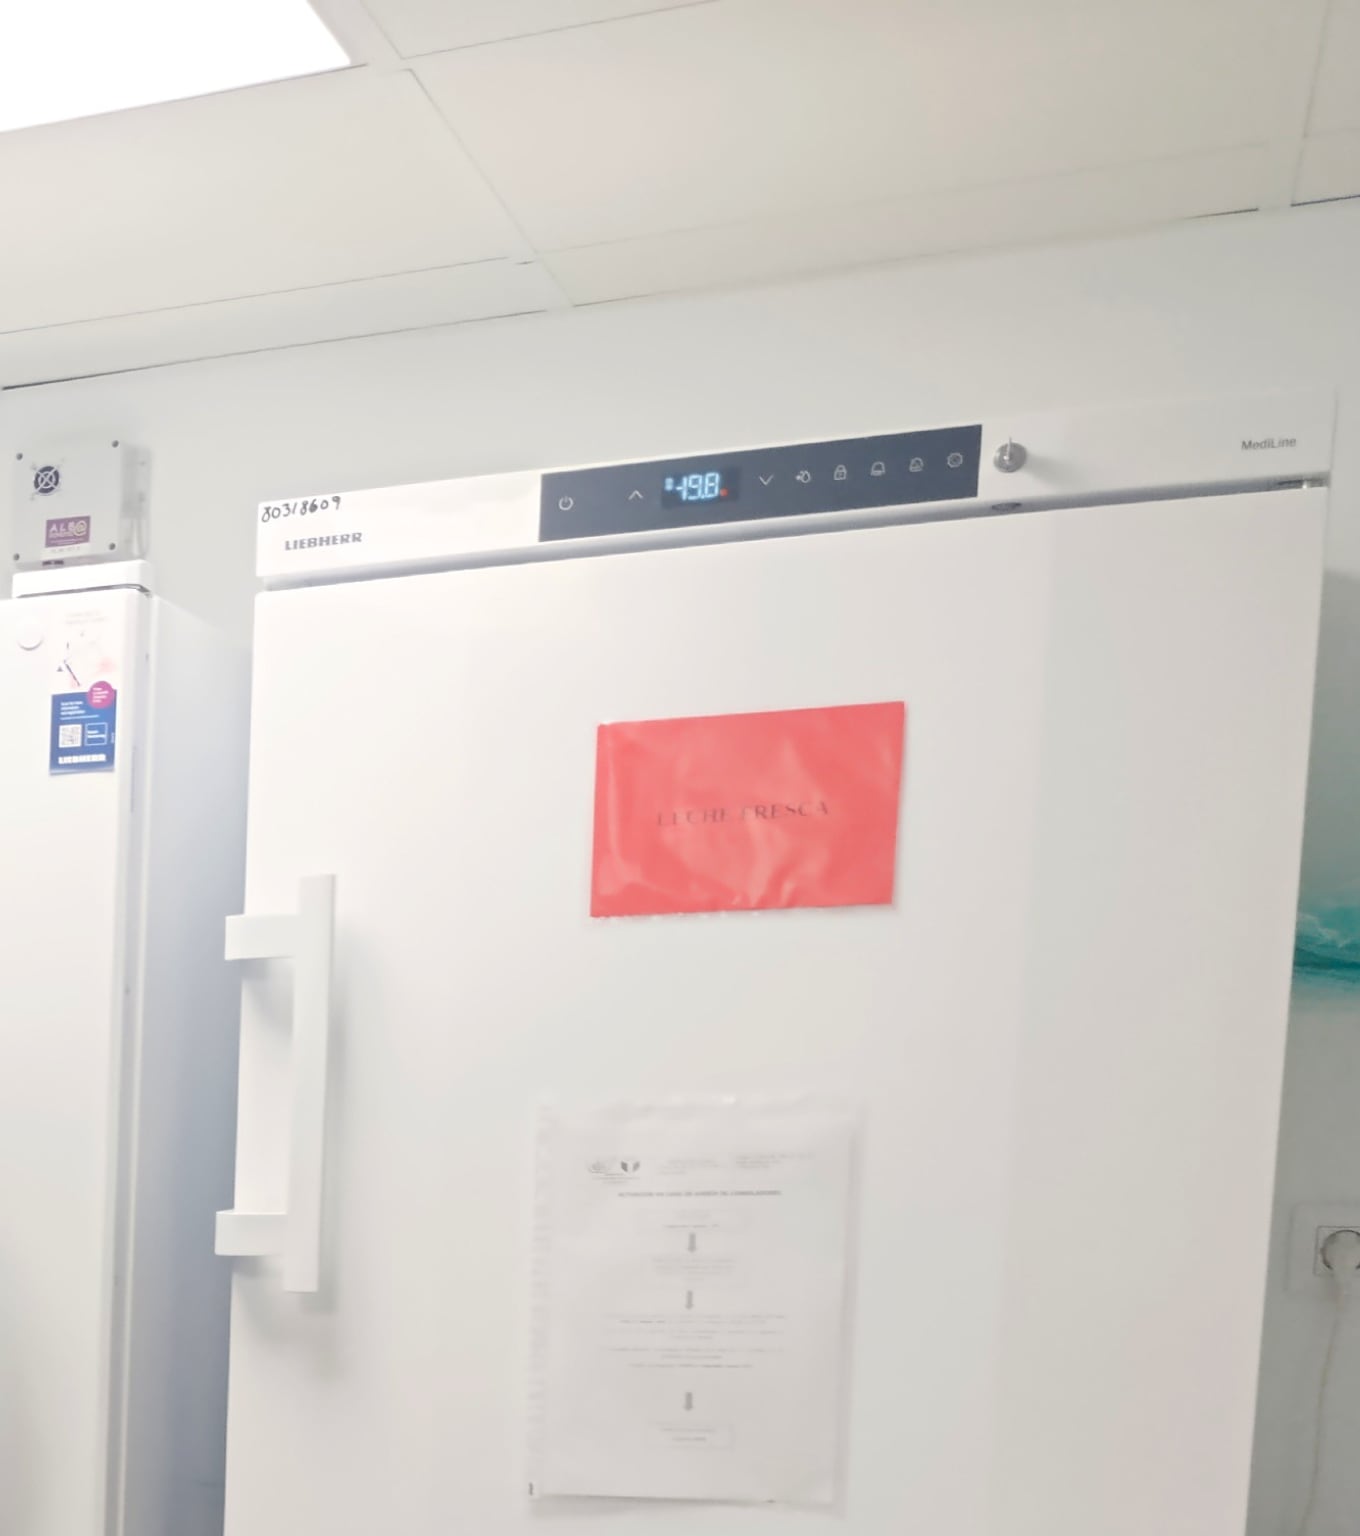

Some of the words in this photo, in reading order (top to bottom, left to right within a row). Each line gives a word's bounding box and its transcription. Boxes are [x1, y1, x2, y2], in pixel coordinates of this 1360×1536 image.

[1241, 438, 1296, 449] MediLine
[261, 495, 341, 523] 80318609
[284, 532, 362, 551] LIEBHERR
